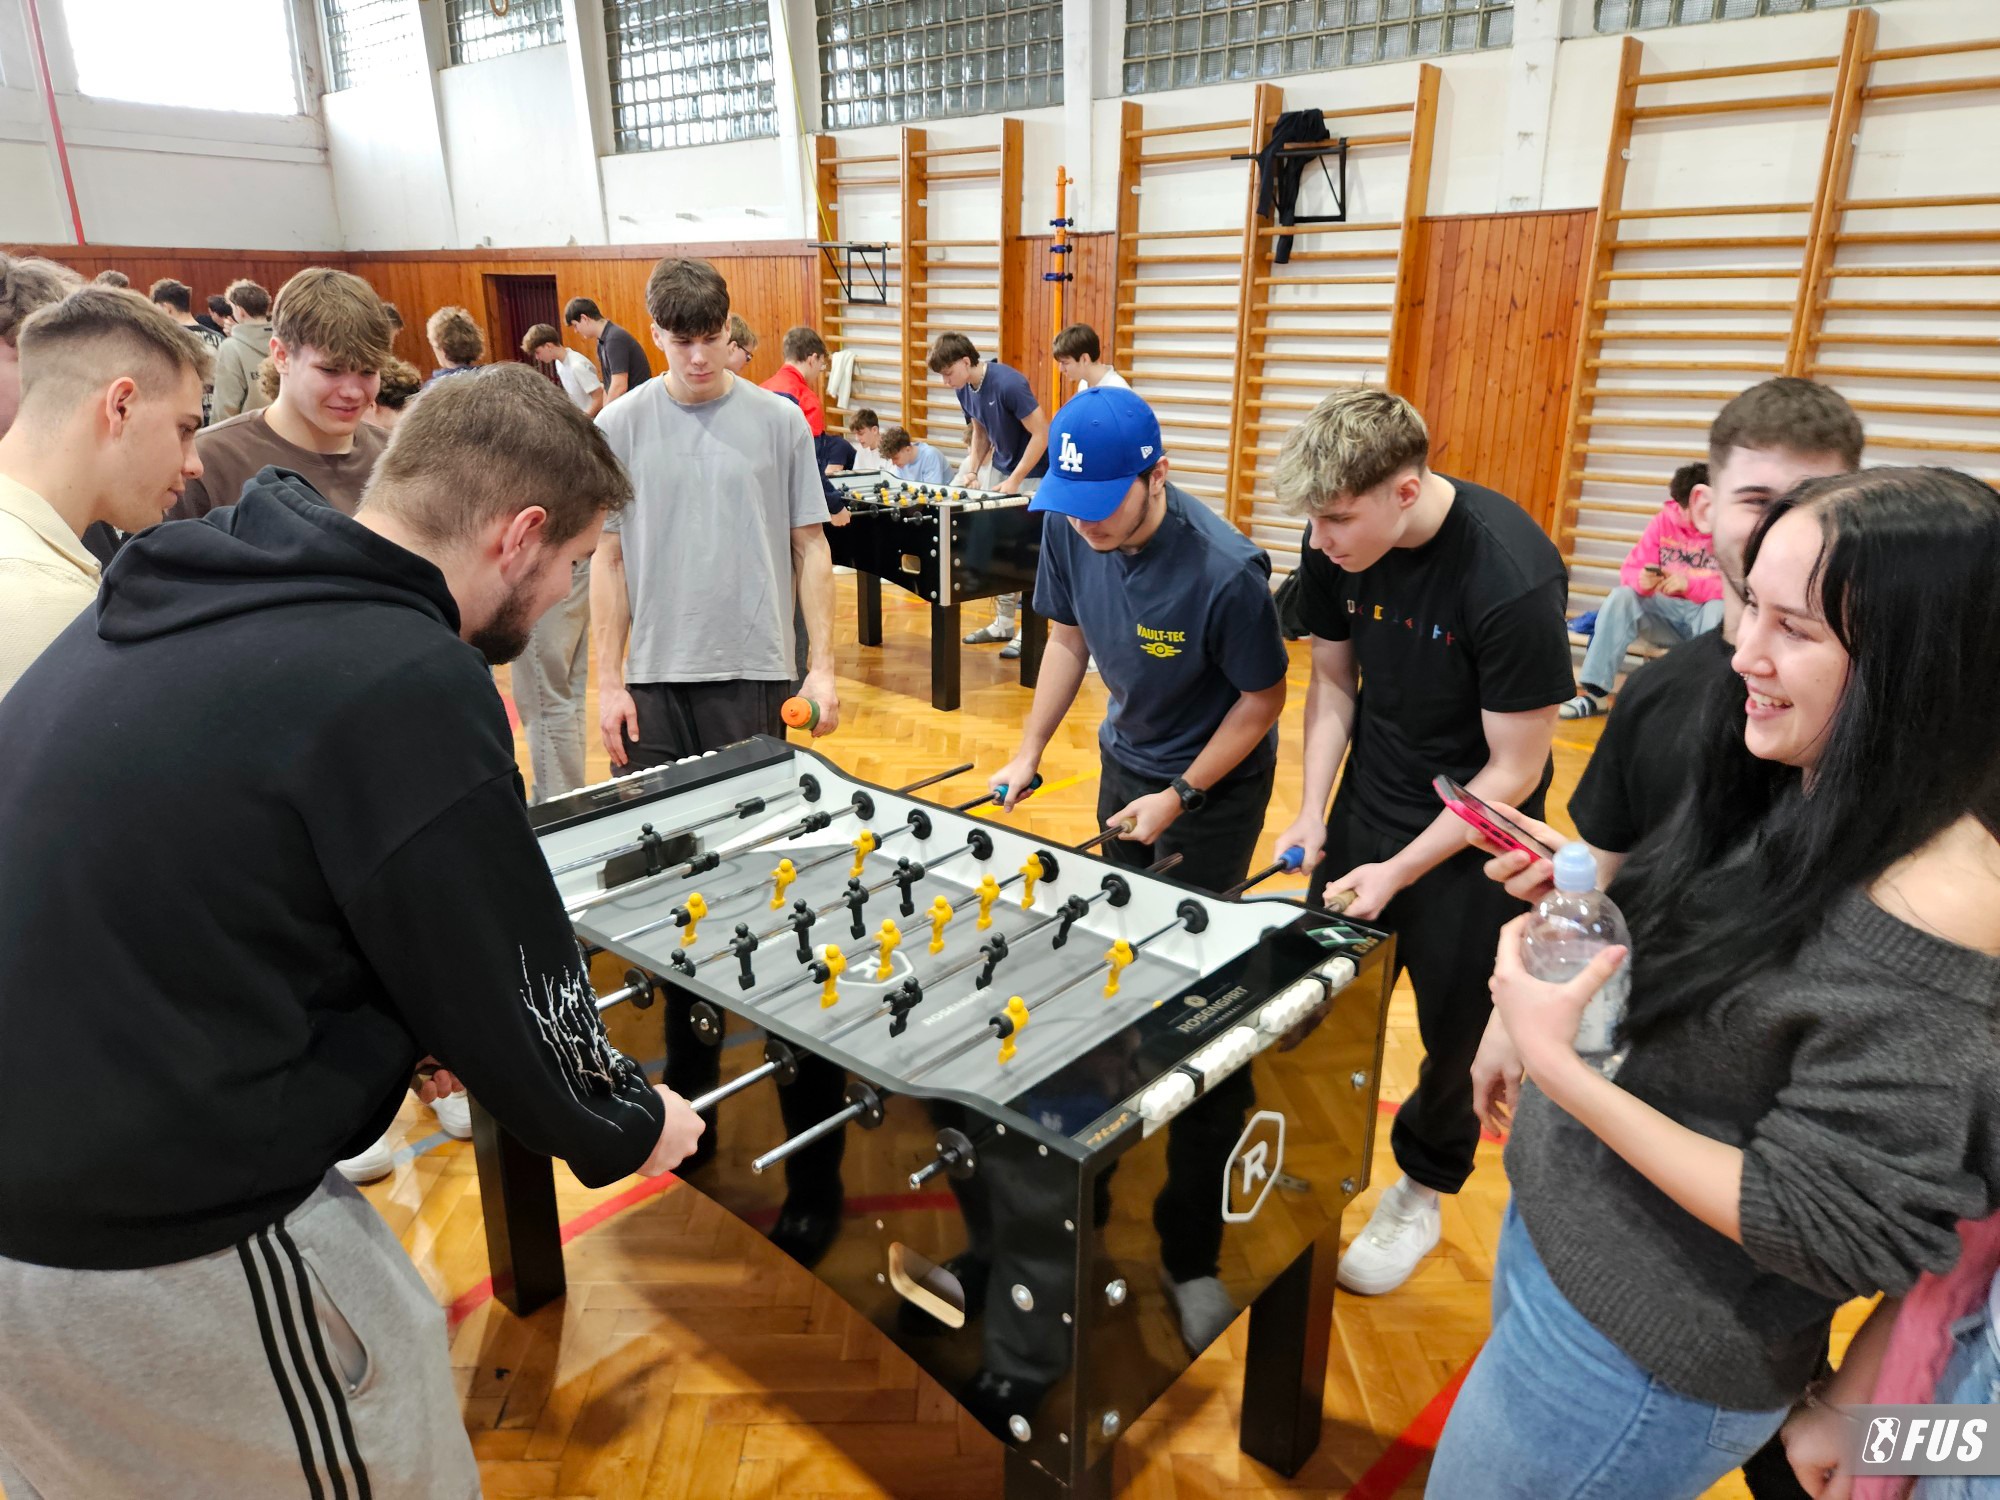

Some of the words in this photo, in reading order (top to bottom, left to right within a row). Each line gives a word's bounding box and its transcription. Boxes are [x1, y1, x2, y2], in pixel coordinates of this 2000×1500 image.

[1058, 432, 1083, 472] LA
[1137, 623, 1186, 642] VAULT-TEC
[1176, 985, 1248, 1033] ROSENGART
[1241, 1140, 1268, 1195] R
